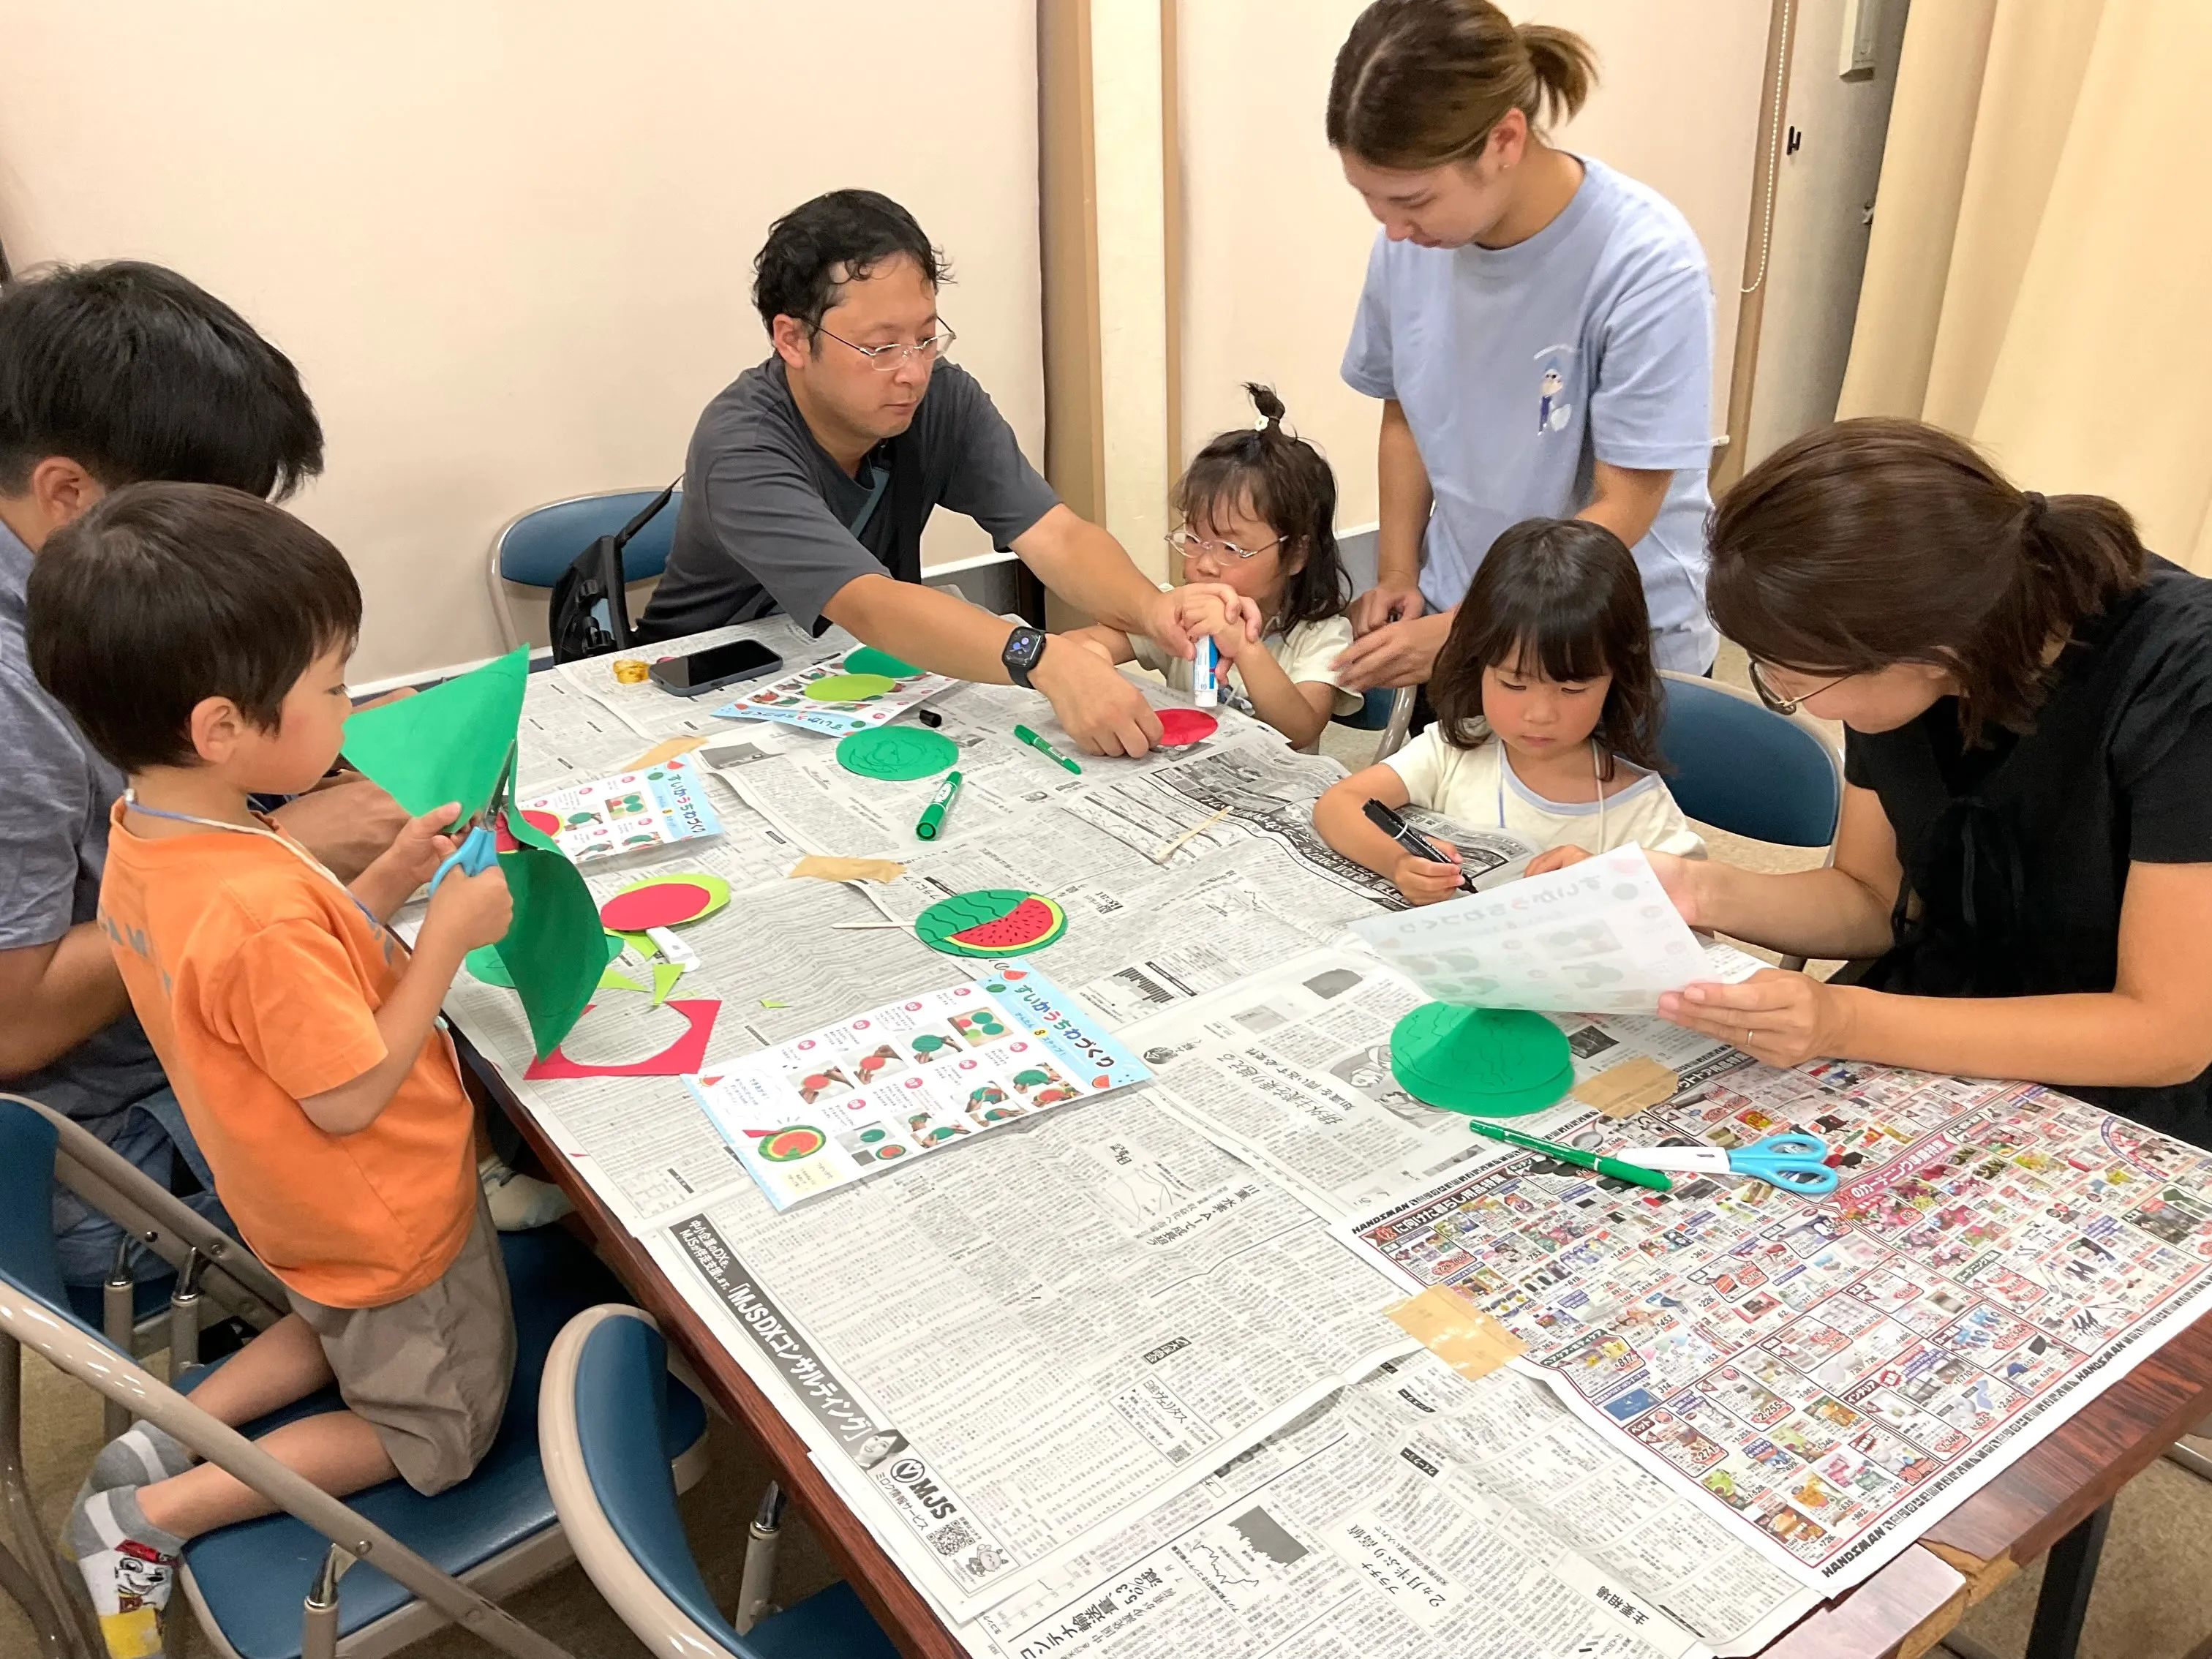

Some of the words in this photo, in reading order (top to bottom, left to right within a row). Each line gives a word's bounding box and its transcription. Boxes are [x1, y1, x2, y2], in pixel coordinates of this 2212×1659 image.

[668, 775, 707, 833] すいかうちわづくり
[1014, 983, 1116, 1069] すいかうちわづくり
[1216, 1052, 1343, 1126] 排外主義を乗り越える
[1353, 1201, 1409, 1234] HANDSMAN
[727, 1282, 873, 1442] 「MJSDXコンサルティング」
[2076, 1341, 2126, 1382] HANDSMAN
[1143, 1380, 1188, 1423] 日経ヴェリタス
[876, 1472, 928, 1531] ミロク情報サービス
[910, 1478, 957, 1520] MJS
[1823, 1527, 1884, 1577] HANDSMAN
[1362, 1562, 1399, 1595] プラチナ
[1595, 1585, 1649, 1625] 主要相場
